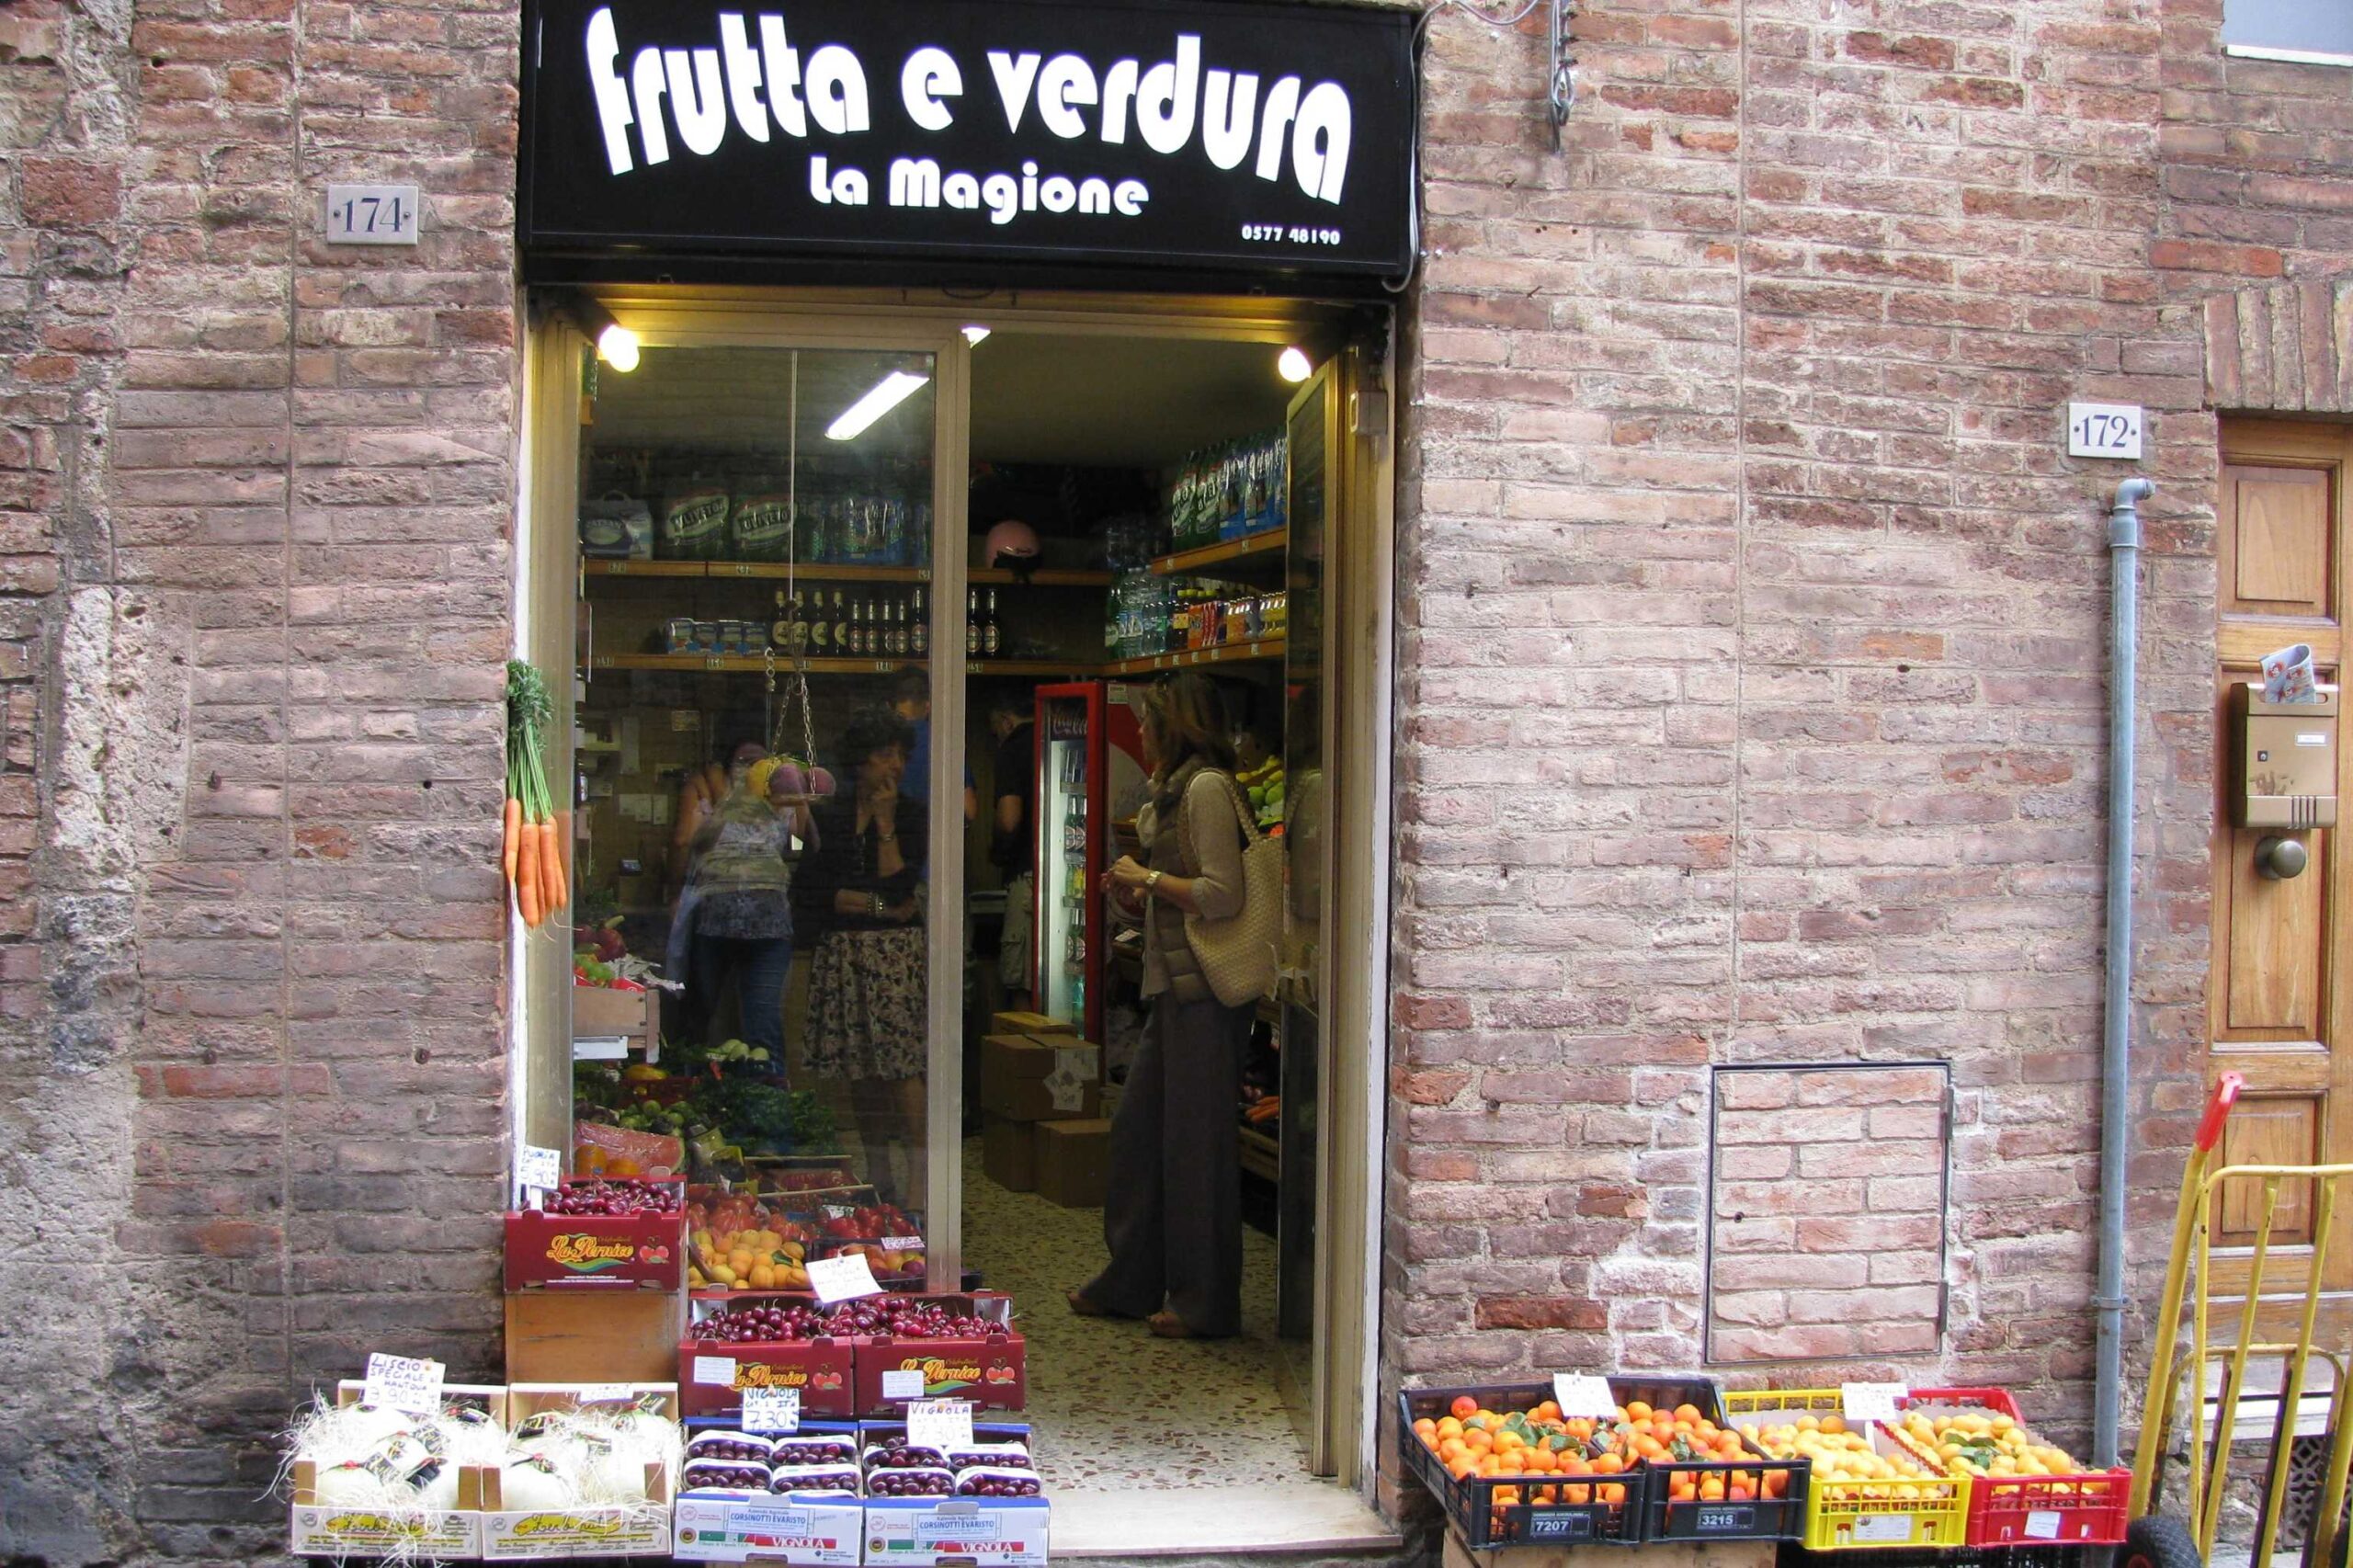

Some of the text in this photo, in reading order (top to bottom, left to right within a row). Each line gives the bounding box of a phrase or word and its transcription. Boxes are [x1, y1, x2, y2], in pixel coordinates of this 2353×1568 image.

[585, 7, 1352, 205] frutta e verdura
[810, 155, 1150, 225] La Magione
[342, 196, 403, 233] 174
[1241, 224, 1341, 245] 0577 48190
[2081, 414, 2129, 448] 172
[772, 1516, 806, 1525] EVARISTO
[961, 1520, 995, 1528] EVARISTO
[1536, 1520, 1569, 1531] 7207
[1702, 1515, 1733, 1526] 3215
[772, 1537, 824, 1549] VIGNOLA
[961, 1541, 1013, 1553] VIGNOLA
